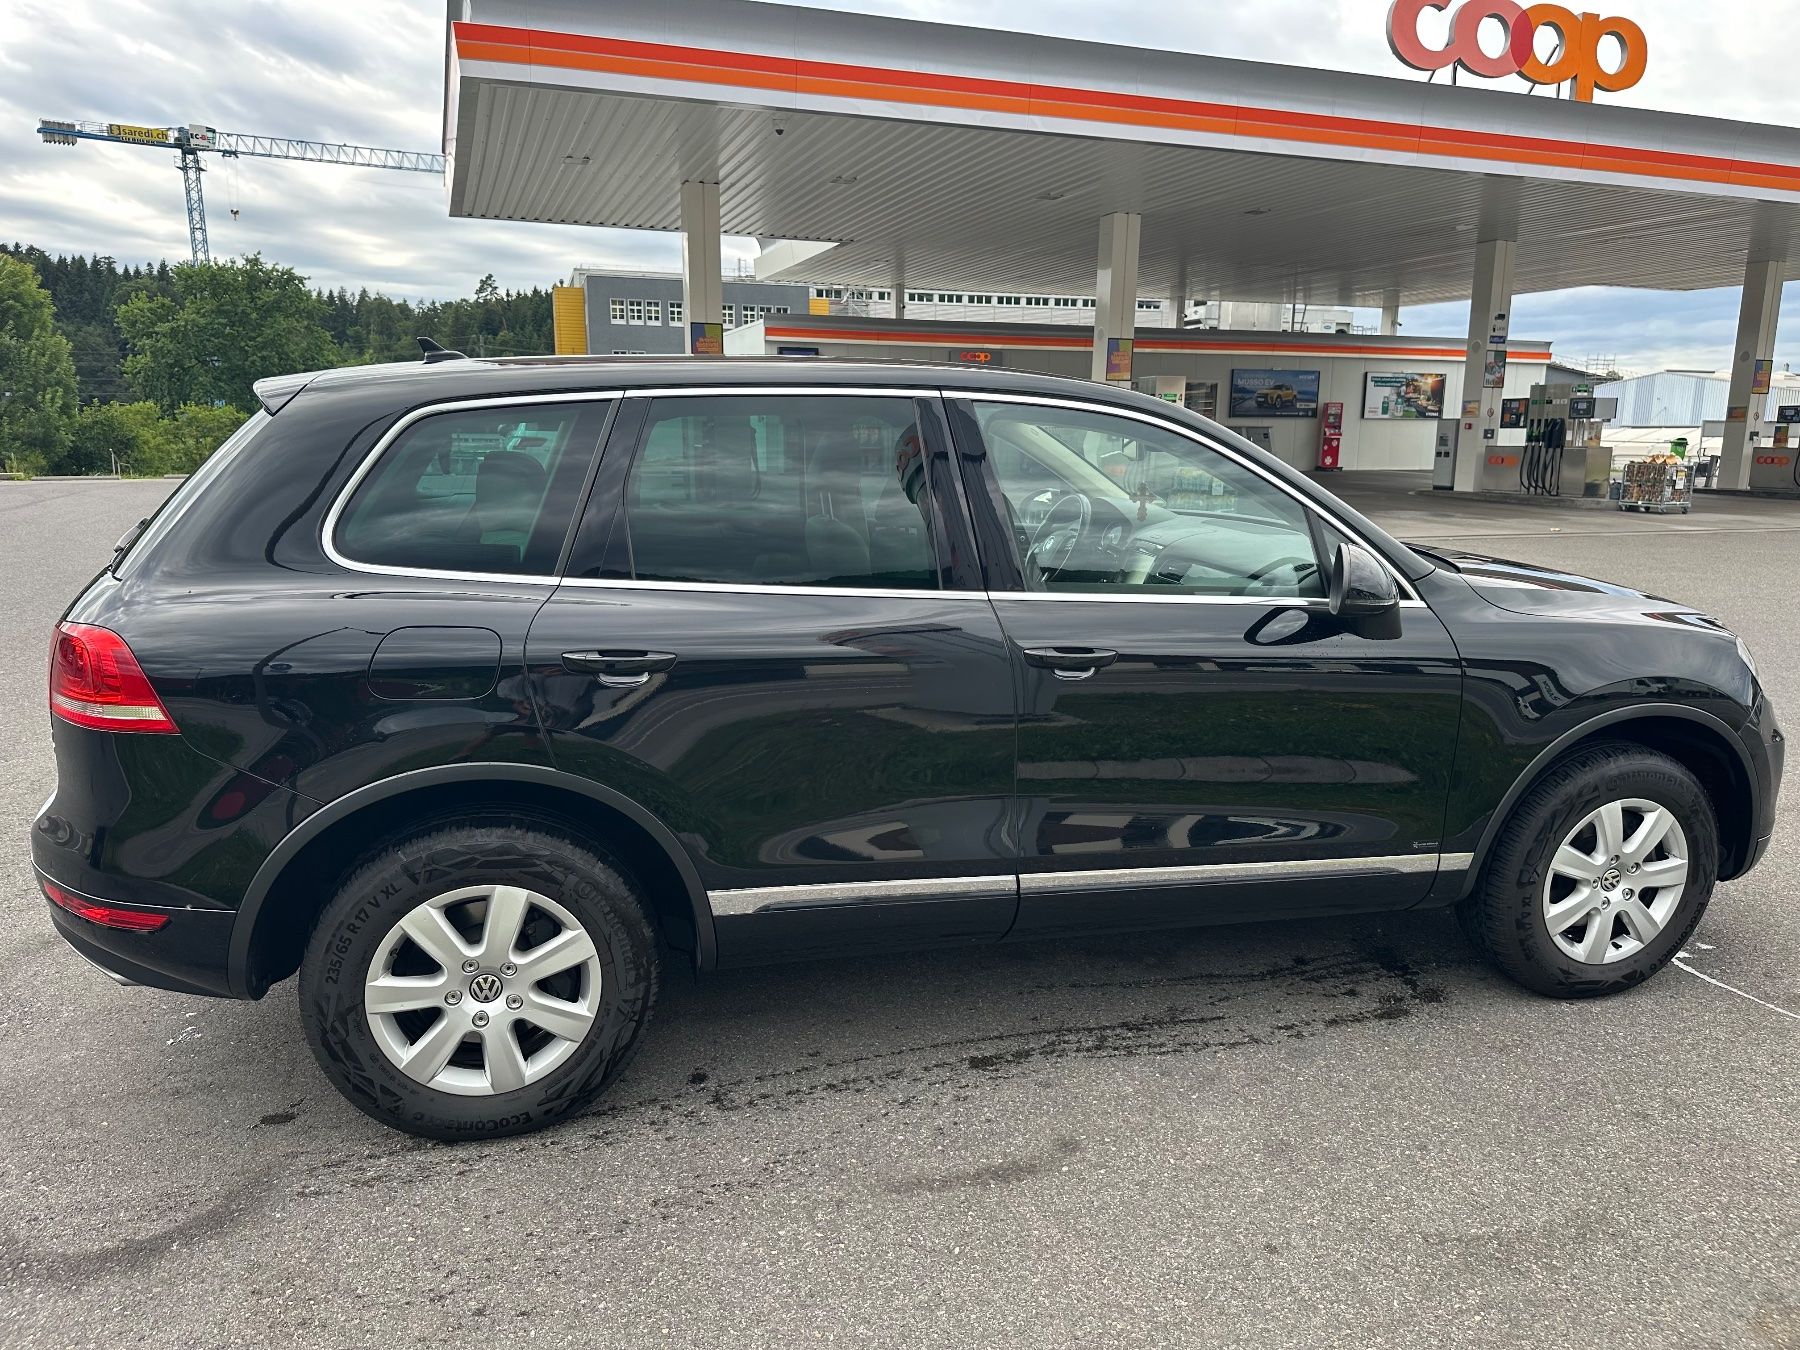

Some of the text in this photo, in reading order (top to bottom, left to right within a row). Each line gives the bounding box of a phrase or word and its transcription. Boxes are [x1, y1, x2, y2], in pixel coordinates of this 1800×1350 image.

[1386, 0, 1648, 103] coop
[122, 127, 168, 140] saredi.ch
[960, 352, 990, 363] coop
[1237, 378, 1264, 386] MUSSO
[325, 935, 352, 984] 235/65
[367, 896, 381, 909] V
[381, 883, 402, 900] XL
